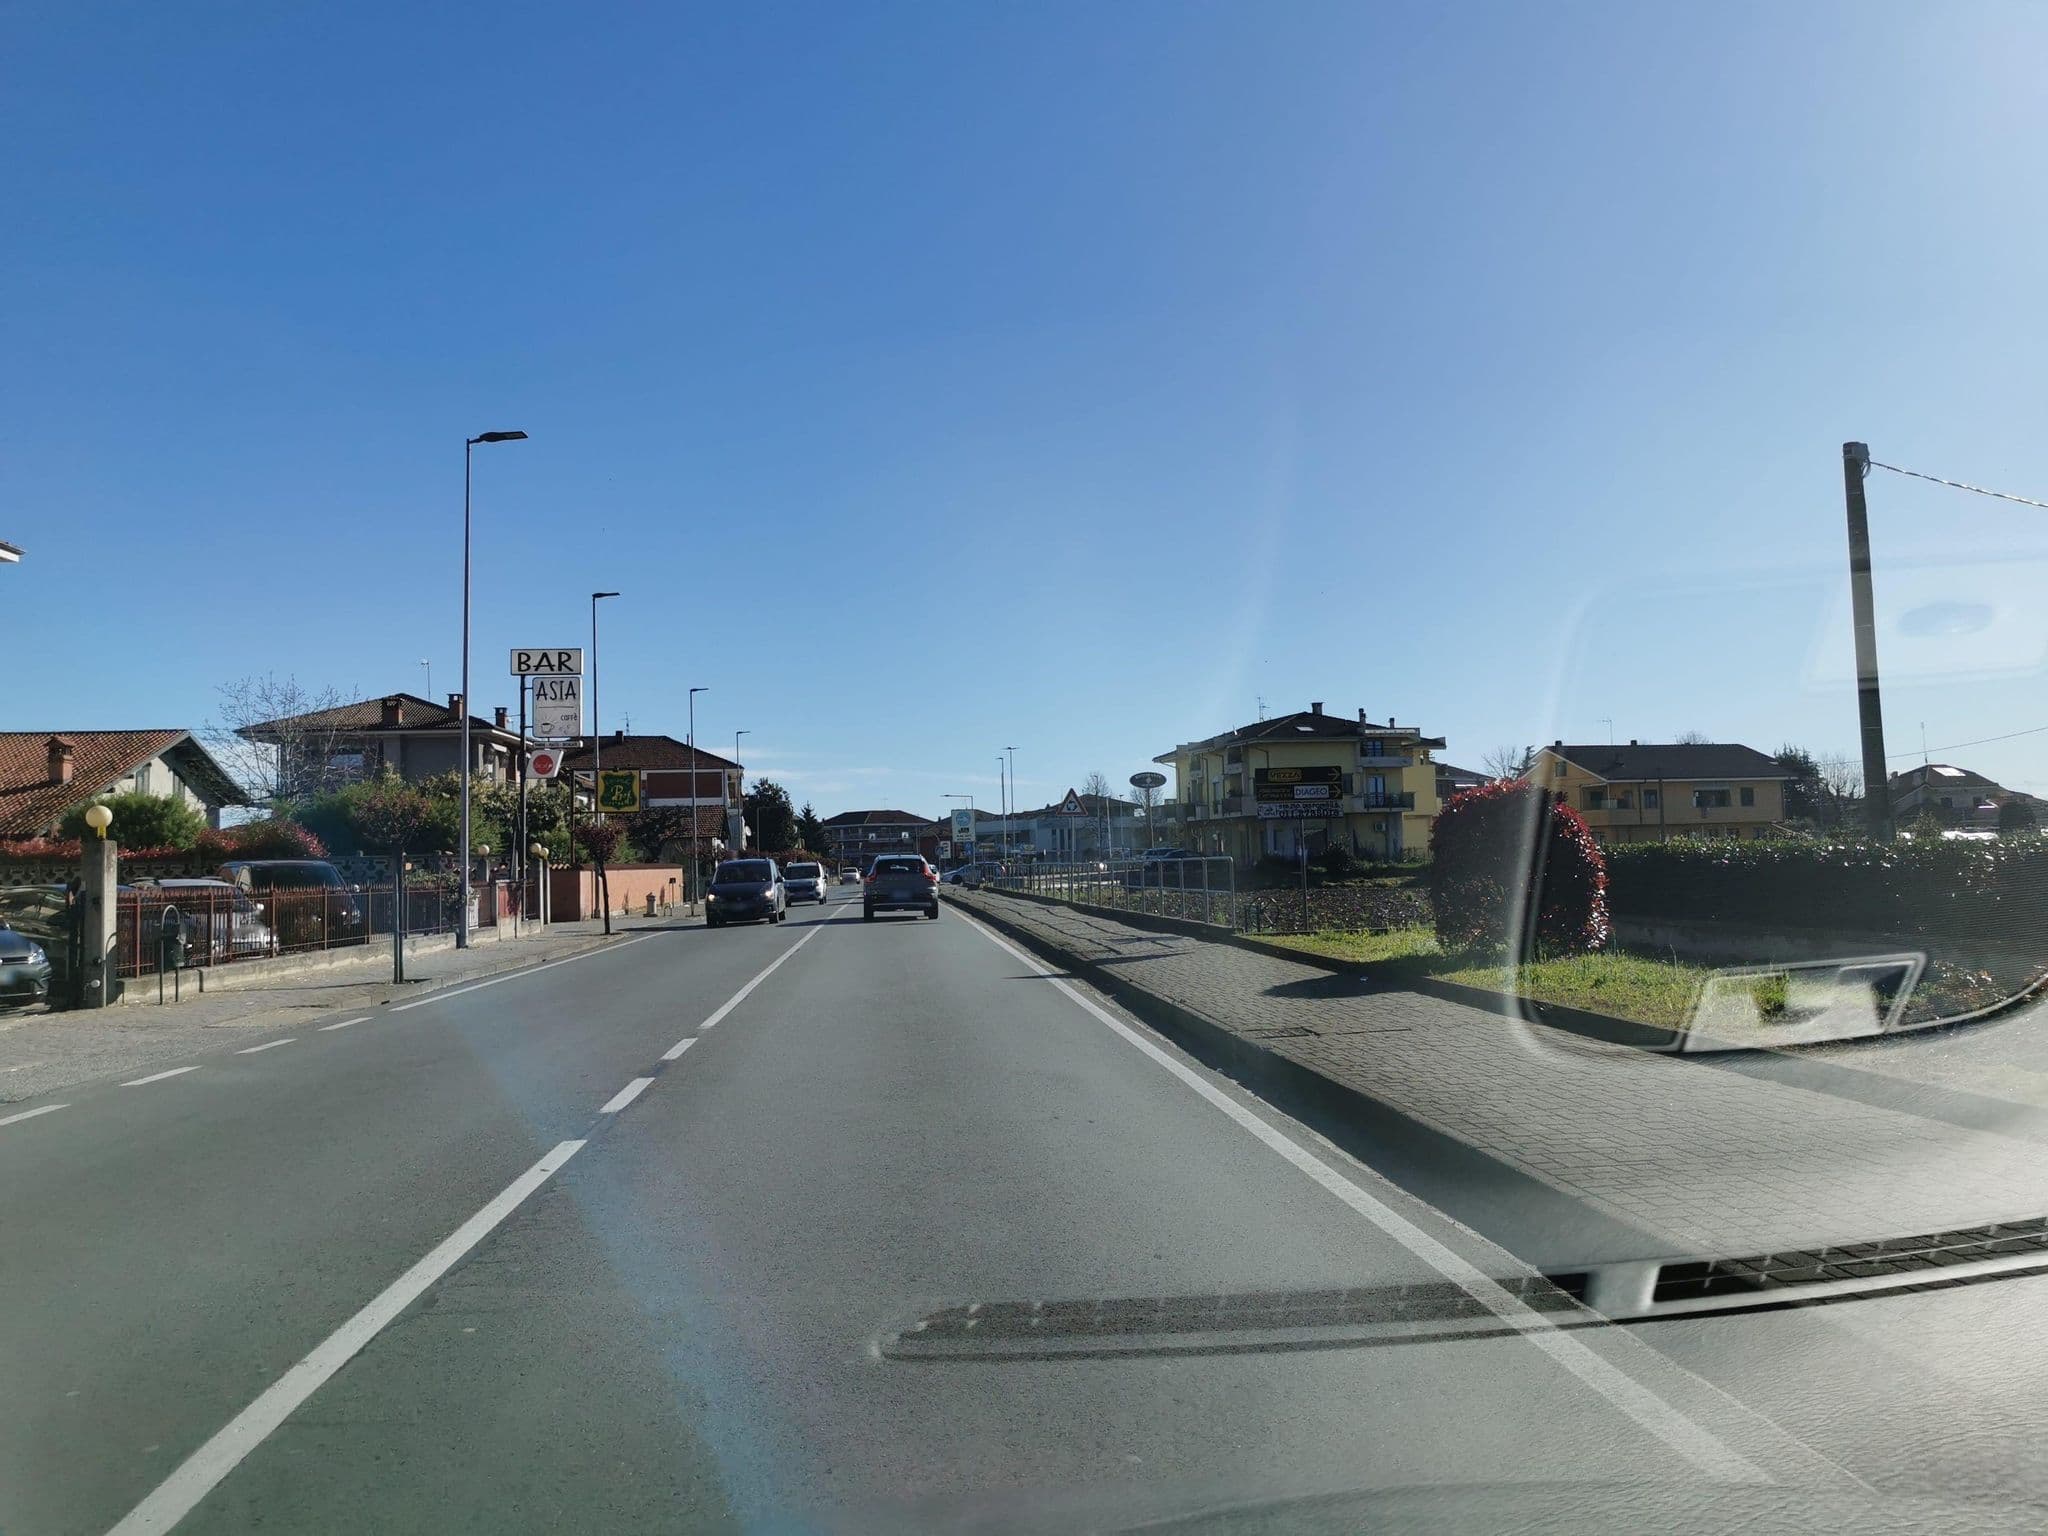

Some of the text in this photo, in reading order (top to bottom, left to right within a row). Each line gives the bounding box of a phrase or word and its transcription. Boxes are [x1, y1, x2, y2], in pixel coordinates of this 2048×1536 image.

[517, 651, 574, 672] BAR
[536, 680, 577, 701] ASIA
[1295, 786, 1328, 796] DIAGEO
